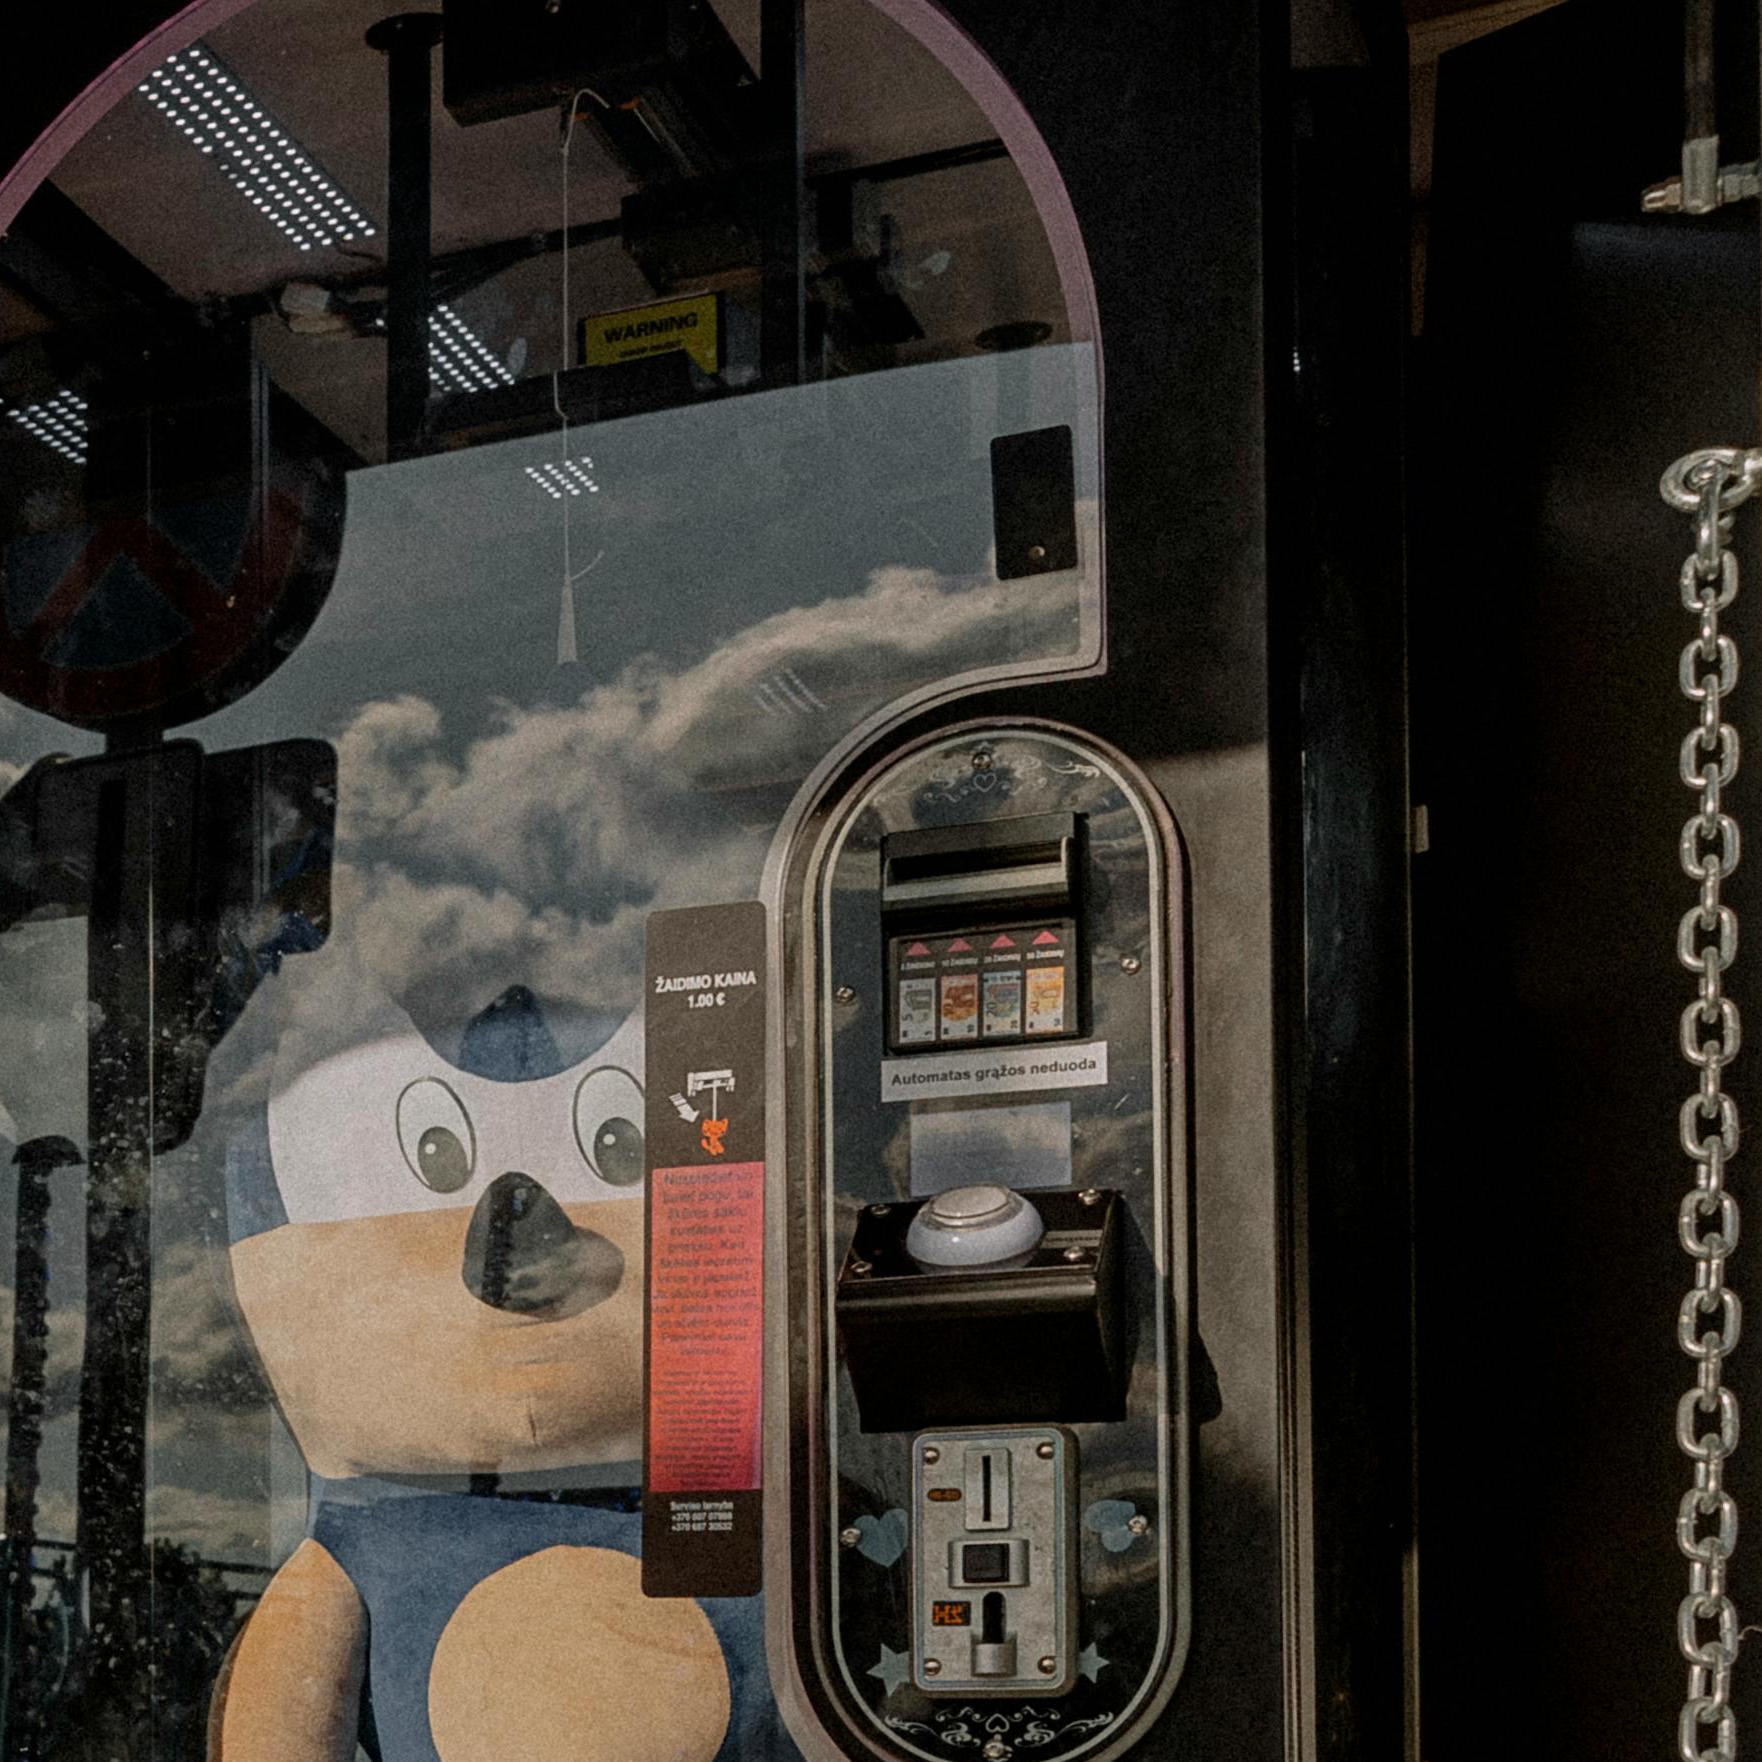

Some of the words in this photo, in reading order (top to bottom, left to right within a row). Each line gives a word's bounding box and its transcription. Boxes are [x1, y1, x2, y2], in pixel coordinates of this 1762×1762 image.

[604, 311, 698, 343] WARNING
[655, 975, 712, 993] ŽAIDIMO
[714, 970, 757, 988] KAINA
[687, 992, 714, 1009] 1.00
[715, 992, 726, 1006] €
[891, 1070, 971, 1086] Automatas
[975, 1065, 1025, 1081] grąžos
[1030, 1059, 1097, 1075] neduoda
